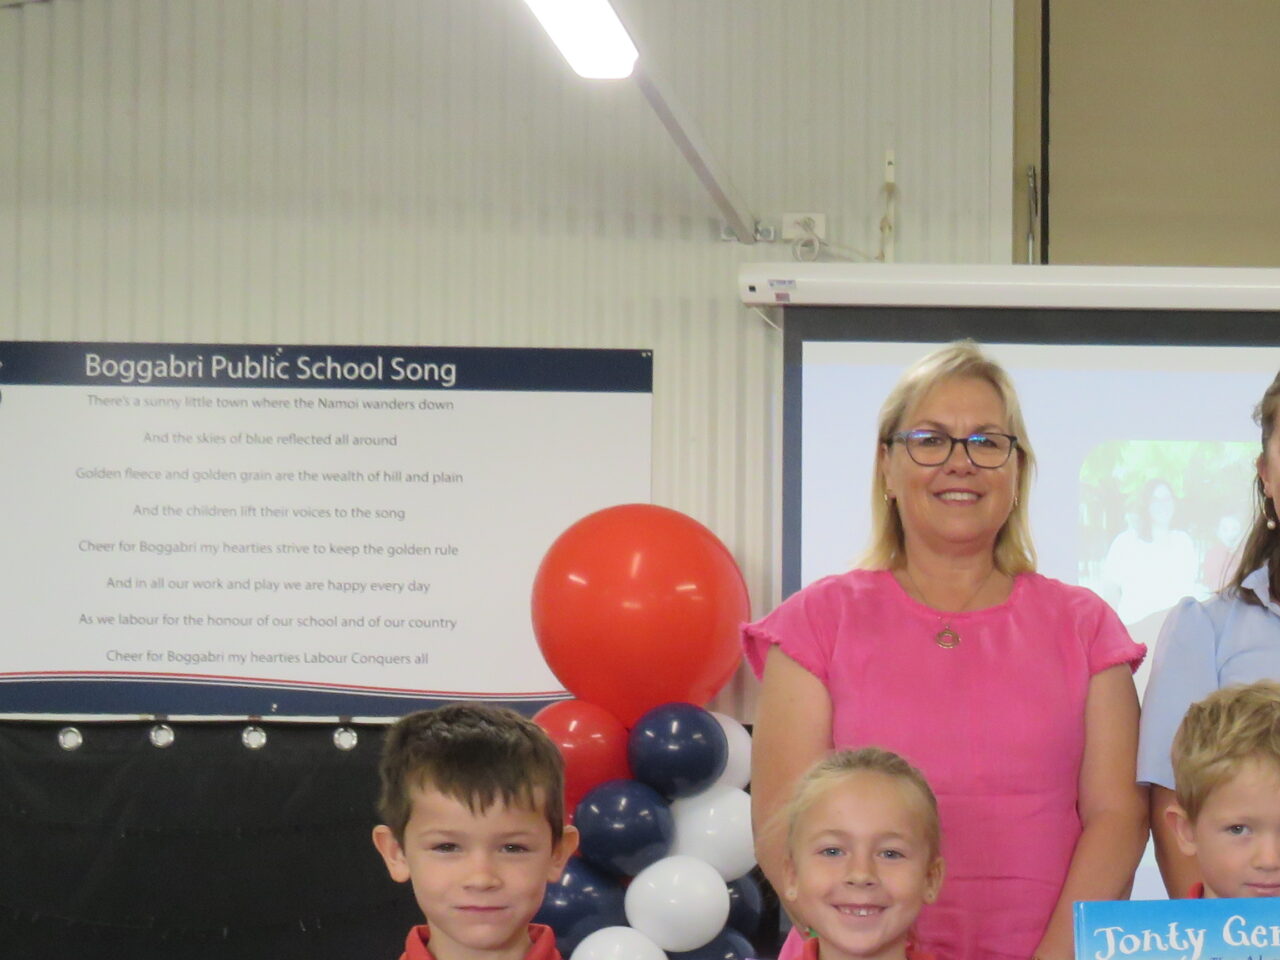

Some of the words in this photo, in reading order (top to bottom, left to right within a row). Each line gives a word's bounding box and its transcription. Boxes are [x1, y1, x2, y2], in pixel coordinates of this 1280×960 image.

[85, 354, 203, 383] Boggabri
[212, 354, 289, 380] Public
[297, 356, 384, 381] School
[391, 358, 457, 386] Song
[144, 432, 169, 443] And
[172, 432, 193, 443] the
[196, 433, 226, 444] skies
[230, 432, 242, 444] of
[246, 433, 274, 444] blue
[276, 433, 332, 445] reflected
[334, 434, 349, 445] all
[352, 435, 398, 446] around
[106, 577, 132, 588] And
[135, 580, 147, 588] in
[150, 578, 165, 588] all
[168, 580, 189, 589] our
[192, 578, 224, 589] work
[226, 579, 251, 589] and
[254, 579, 280, 592] play
[283, 582, 302, 590] we
[304, 582, 325, 590] are
[327, 580, 368, 593] happy
[370, 583, 405, 593] every
[407, 580, 431, 594] day
[78, 614, 94, 624] As
[96, 616, 115, 624] we
[118, 614, 159, 625] labour
[162, 614, 180, 625] for
[183, 614, 204, 625] the
[207, 615, 253, 626] honour
[256, 615, 270, 626] of
[272, 618, 293, 626] our
[296, 616, 338, 627] school
[341, 616, 365, 627] and
[368, 616, 382, 627] of
[384, 619, 406, 628] our
[408, 618, 457, 631] country
[106, 650, 144, 662] Cheer
[146, 650, 164, 661] for
[167, 650, 224, 665] Boggabri
[228, 654, 247, 665] my
[250, 652, 301, 663] hearties
[304, 652, 348, 663] Labour
[350, 652, 412, 666] Conquers
[414, 653, 429, 664] all
